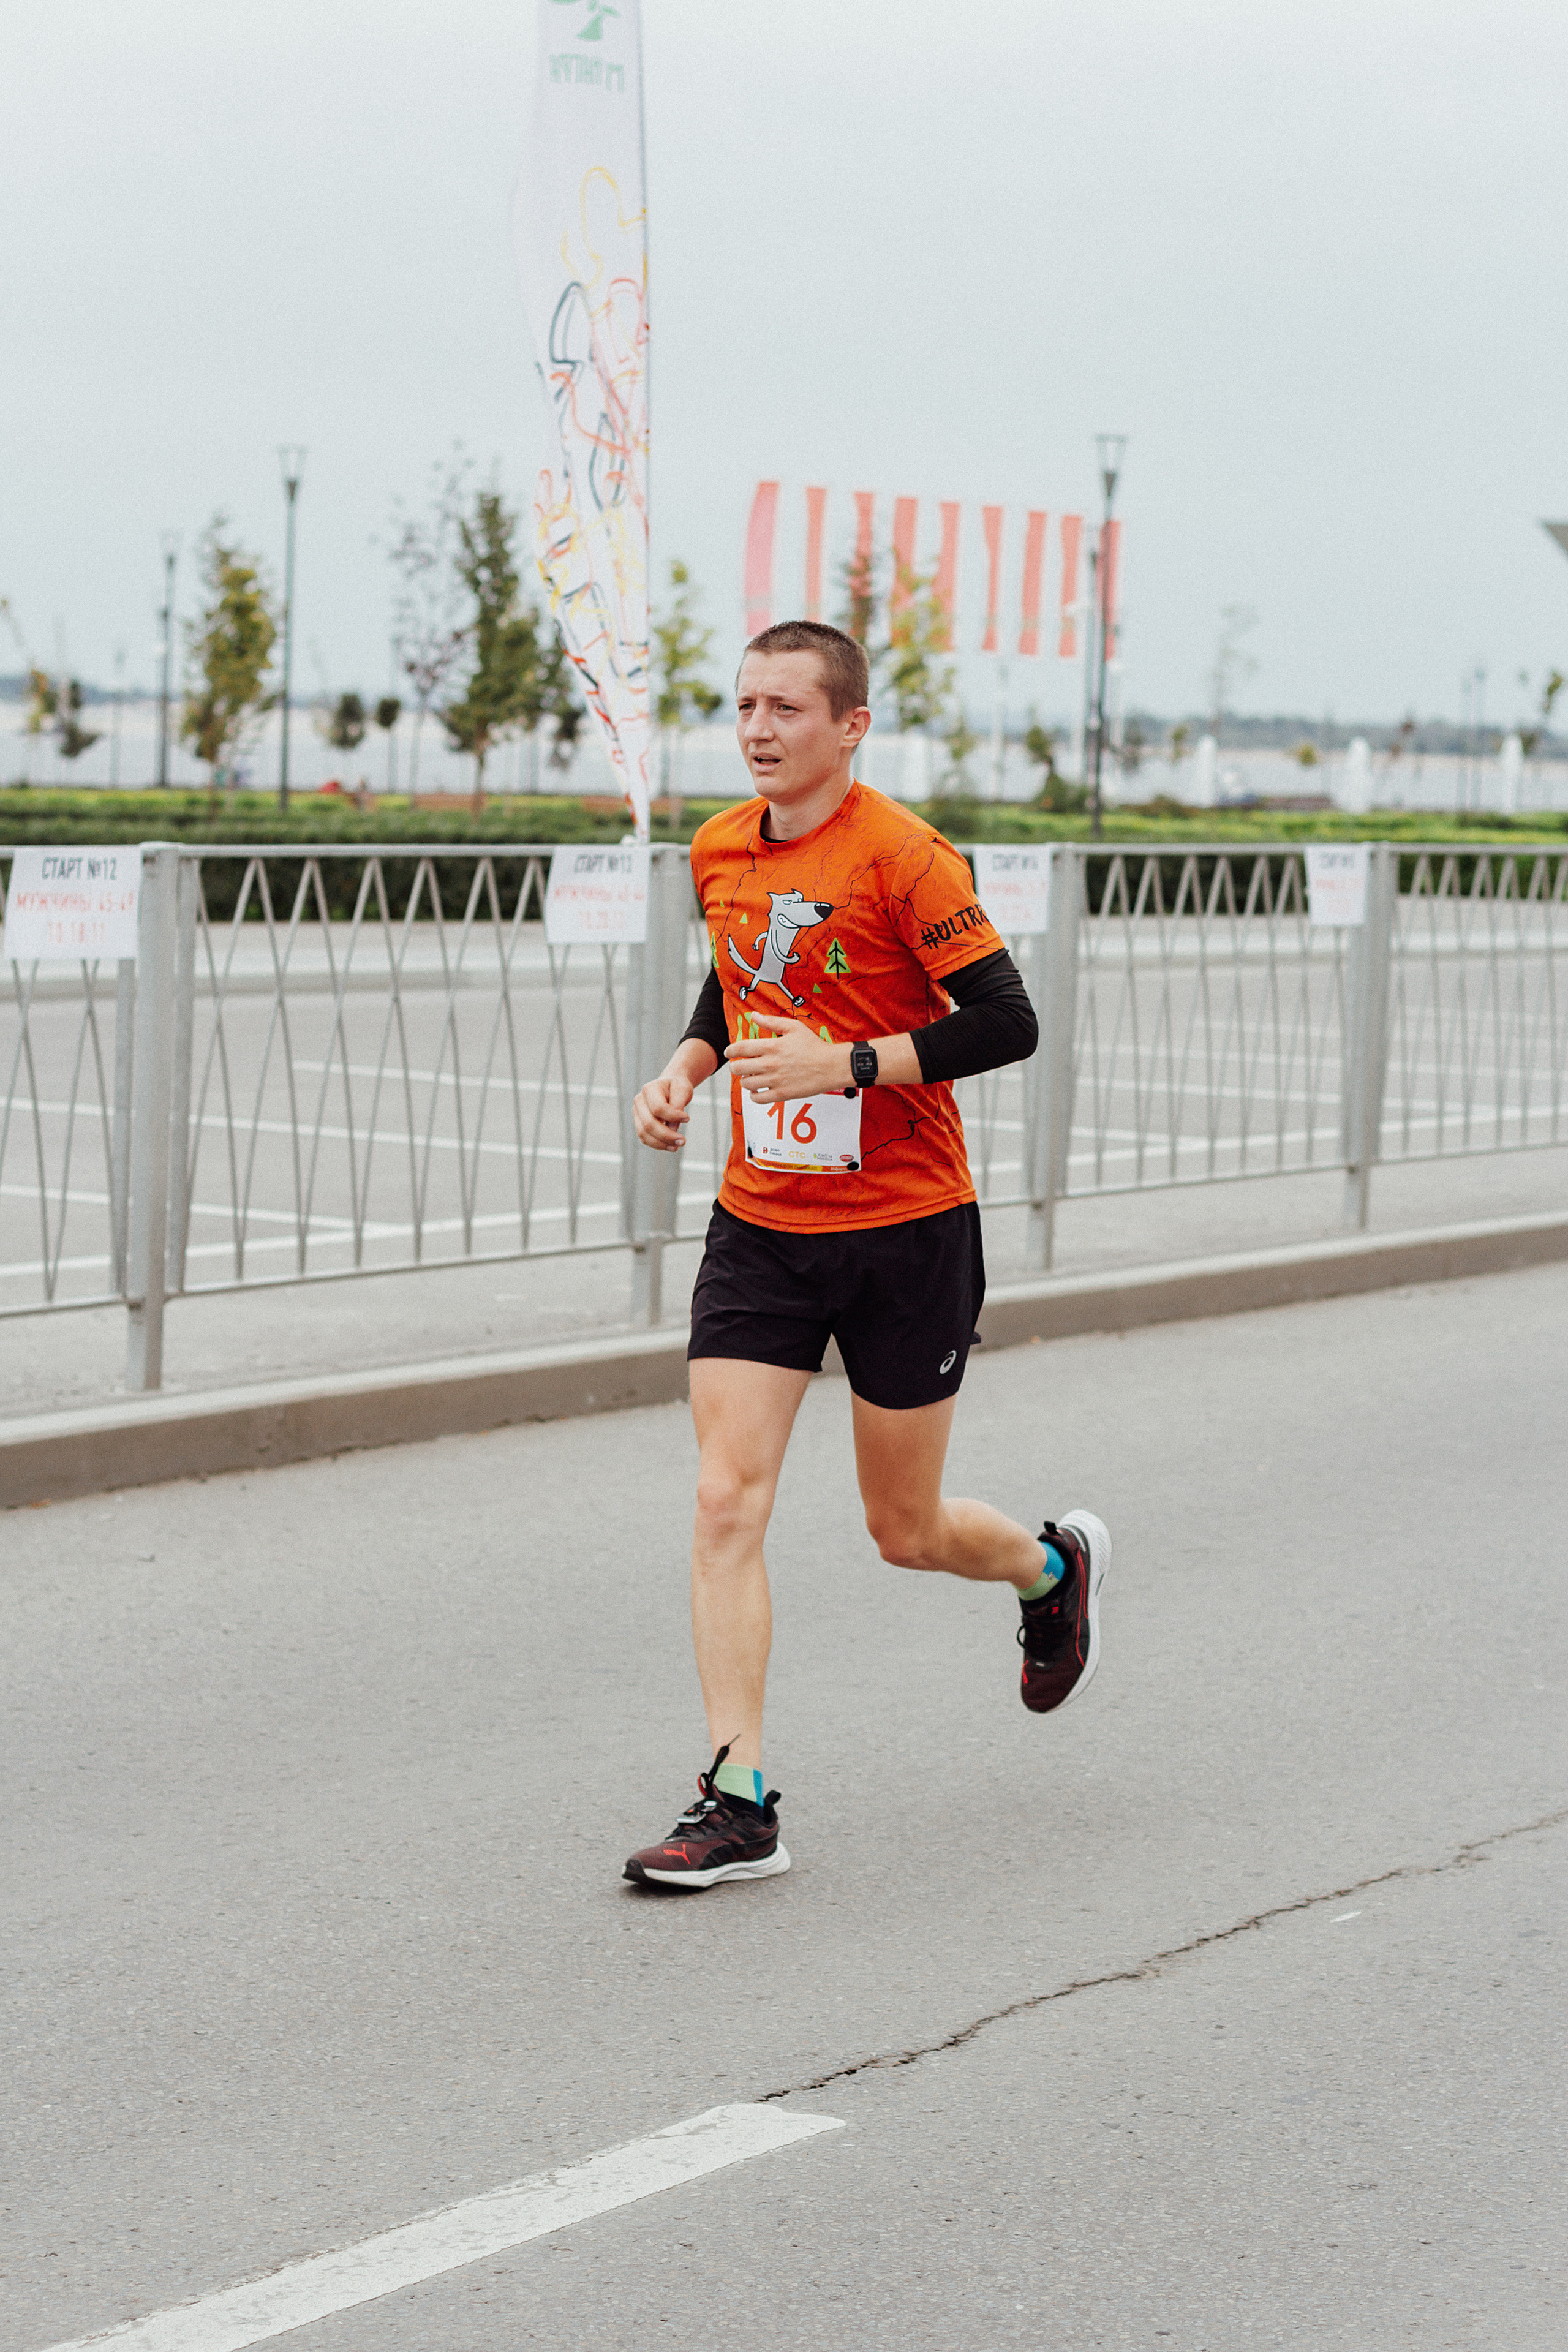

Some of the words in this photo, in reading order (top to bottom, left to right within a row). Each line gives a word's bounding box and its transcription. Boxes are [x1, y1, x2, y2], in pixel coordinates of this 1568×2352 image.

[42, 858, 83, 879] СТАРТ
[87, 858, 117, 880] №12
[767, 1101, 817, 1144] 16
